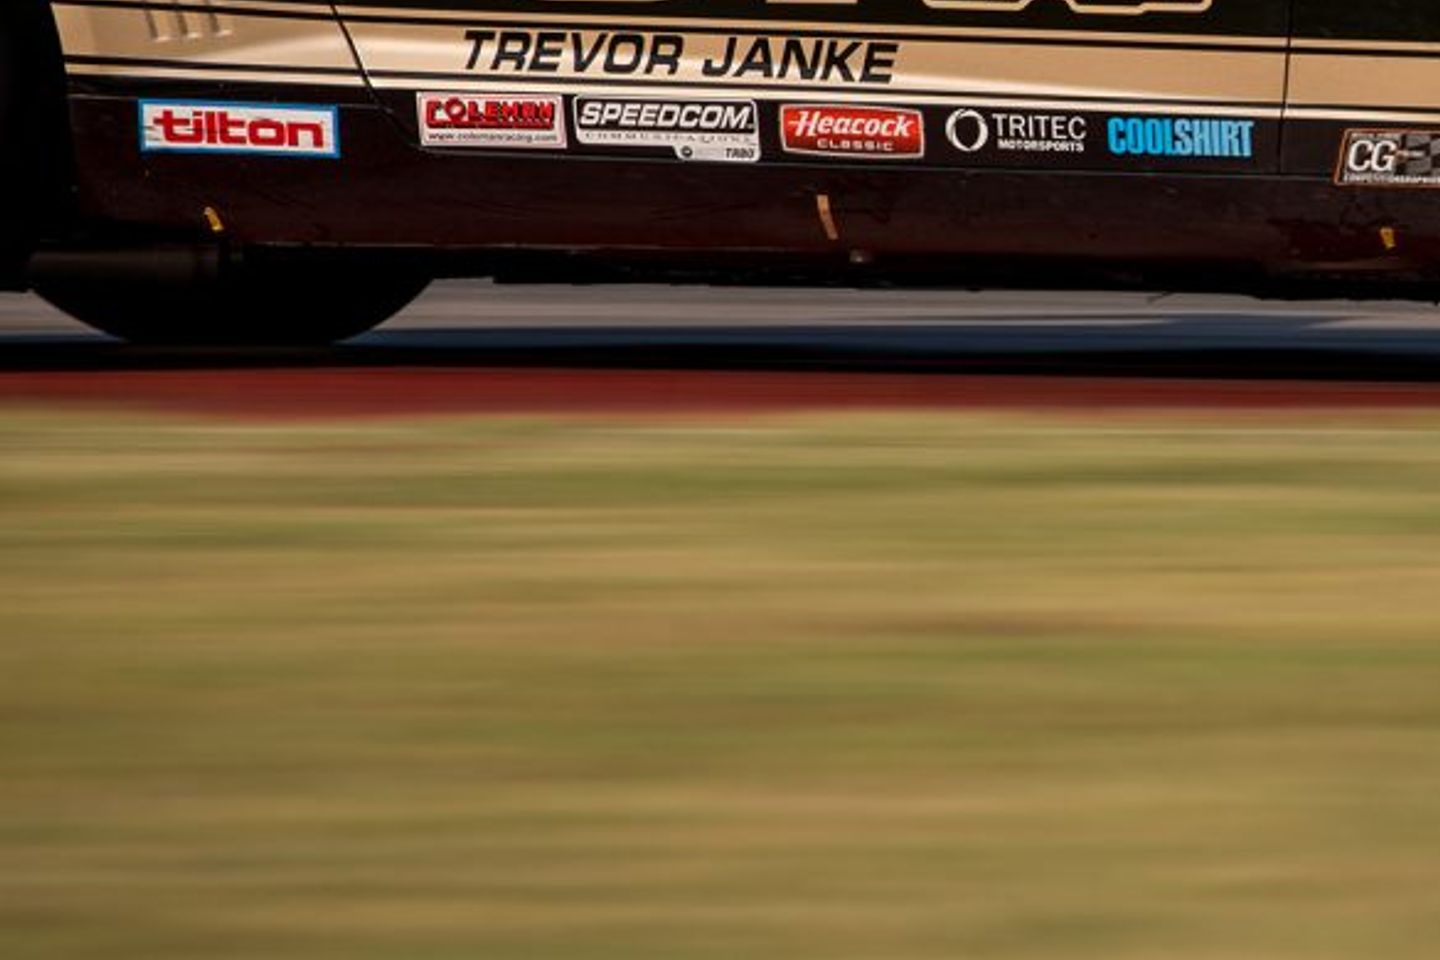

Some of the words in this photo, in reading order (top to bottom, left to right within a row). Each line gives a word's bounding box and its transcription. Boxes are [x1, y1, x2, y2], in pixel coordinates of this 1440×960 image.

[464, 29, 684, 76] TREVOR
[702, 35, 899, 83] JANKE
[154, 109, 325, 148] tilton
[580, 101, 752, 130] SPEEDCOM
[788, 110, 913, 138] Heacock
[992, 113, 1087, 140] TRITEC
[816, 138, 894, 152] CLASSIC
[997, 139, 1085, 153] MOTORSPORTS
[1106, 116, 1254, 158] COOLSHIRT
[1347, 139, 1398, 173] CG
